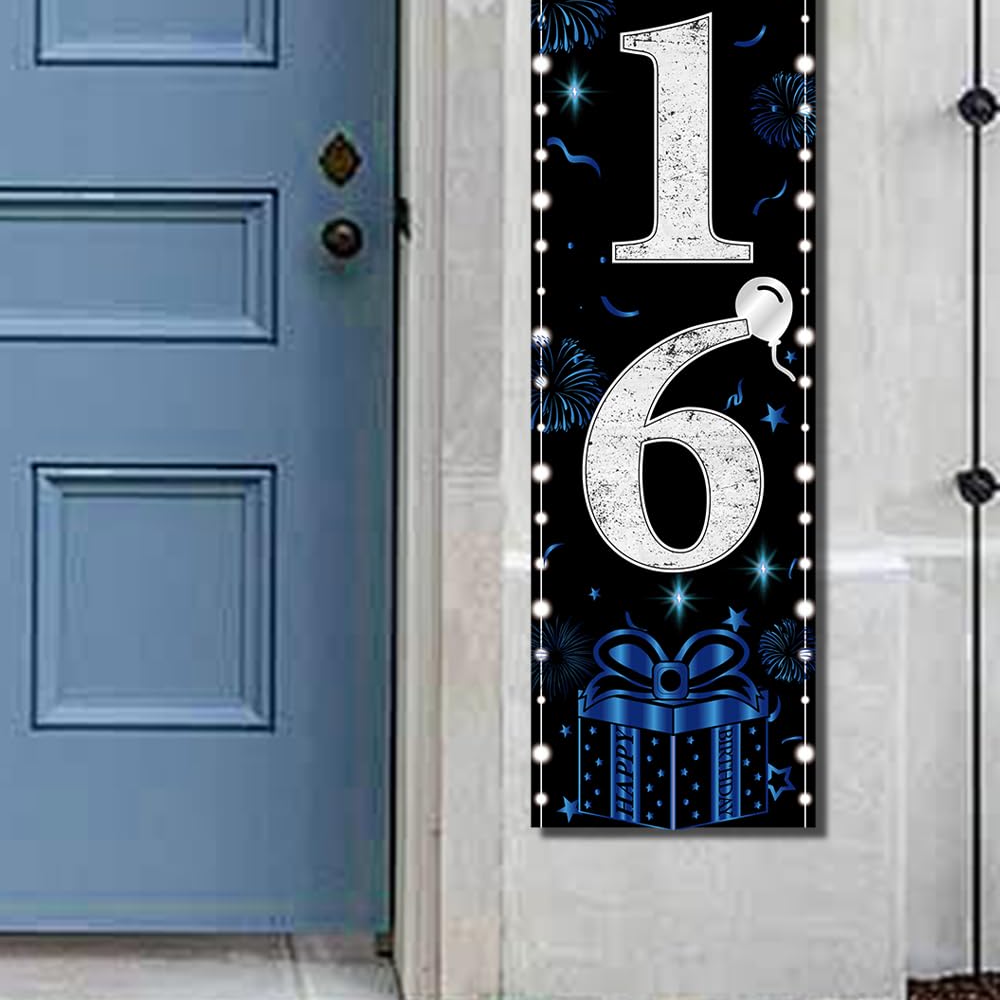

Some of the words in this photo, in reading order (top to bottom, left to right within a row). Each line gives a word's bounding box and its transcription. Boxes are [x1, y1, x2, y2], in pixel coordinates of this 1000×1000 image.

[582, 12, 764, 573] 16
[616, 728, 634, 818] HAPPY
[718, 729, 733, 816] BIRTHDAY
